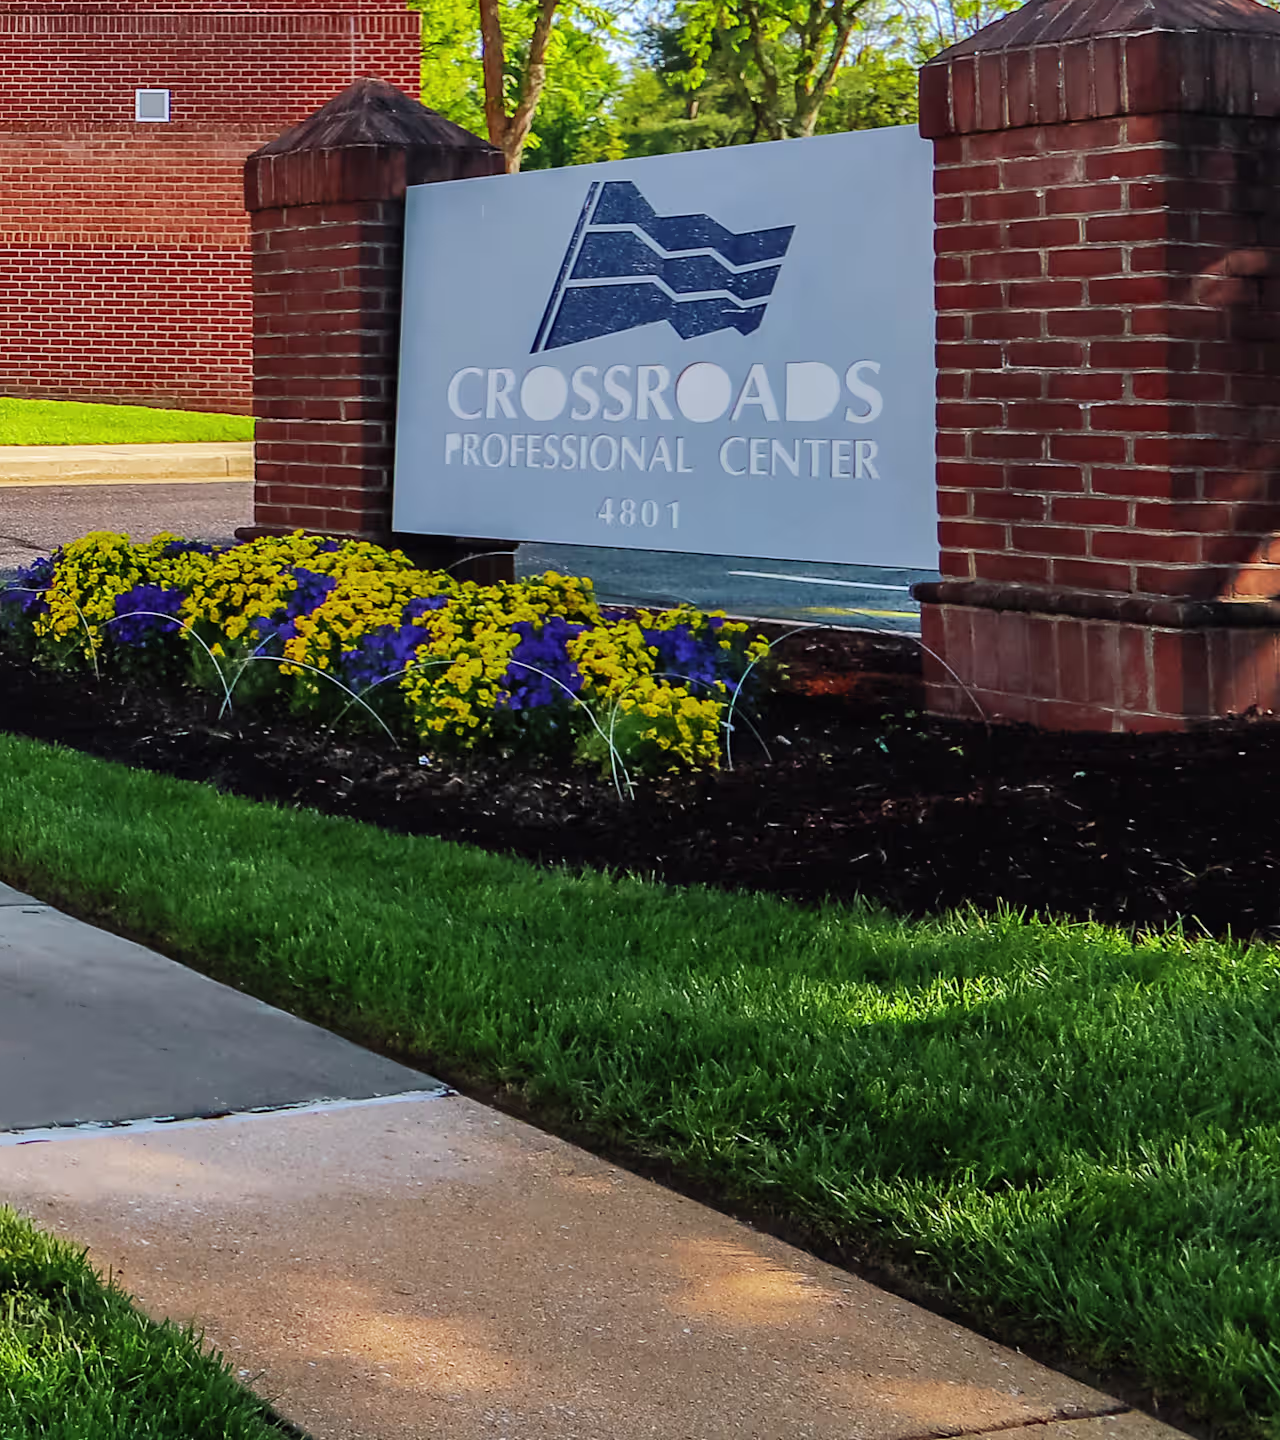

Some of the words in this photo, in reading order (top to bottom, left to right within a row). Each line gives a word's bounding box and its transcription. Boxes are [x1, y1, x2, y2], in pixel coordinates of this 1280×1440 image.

[446, 359, 884, 424] CROSSROADS
[444, 432, 695, 474] PROFESSIONAL
[719, 435, 881, 480] CENTER
[596, 497, 680, 529] 4801
